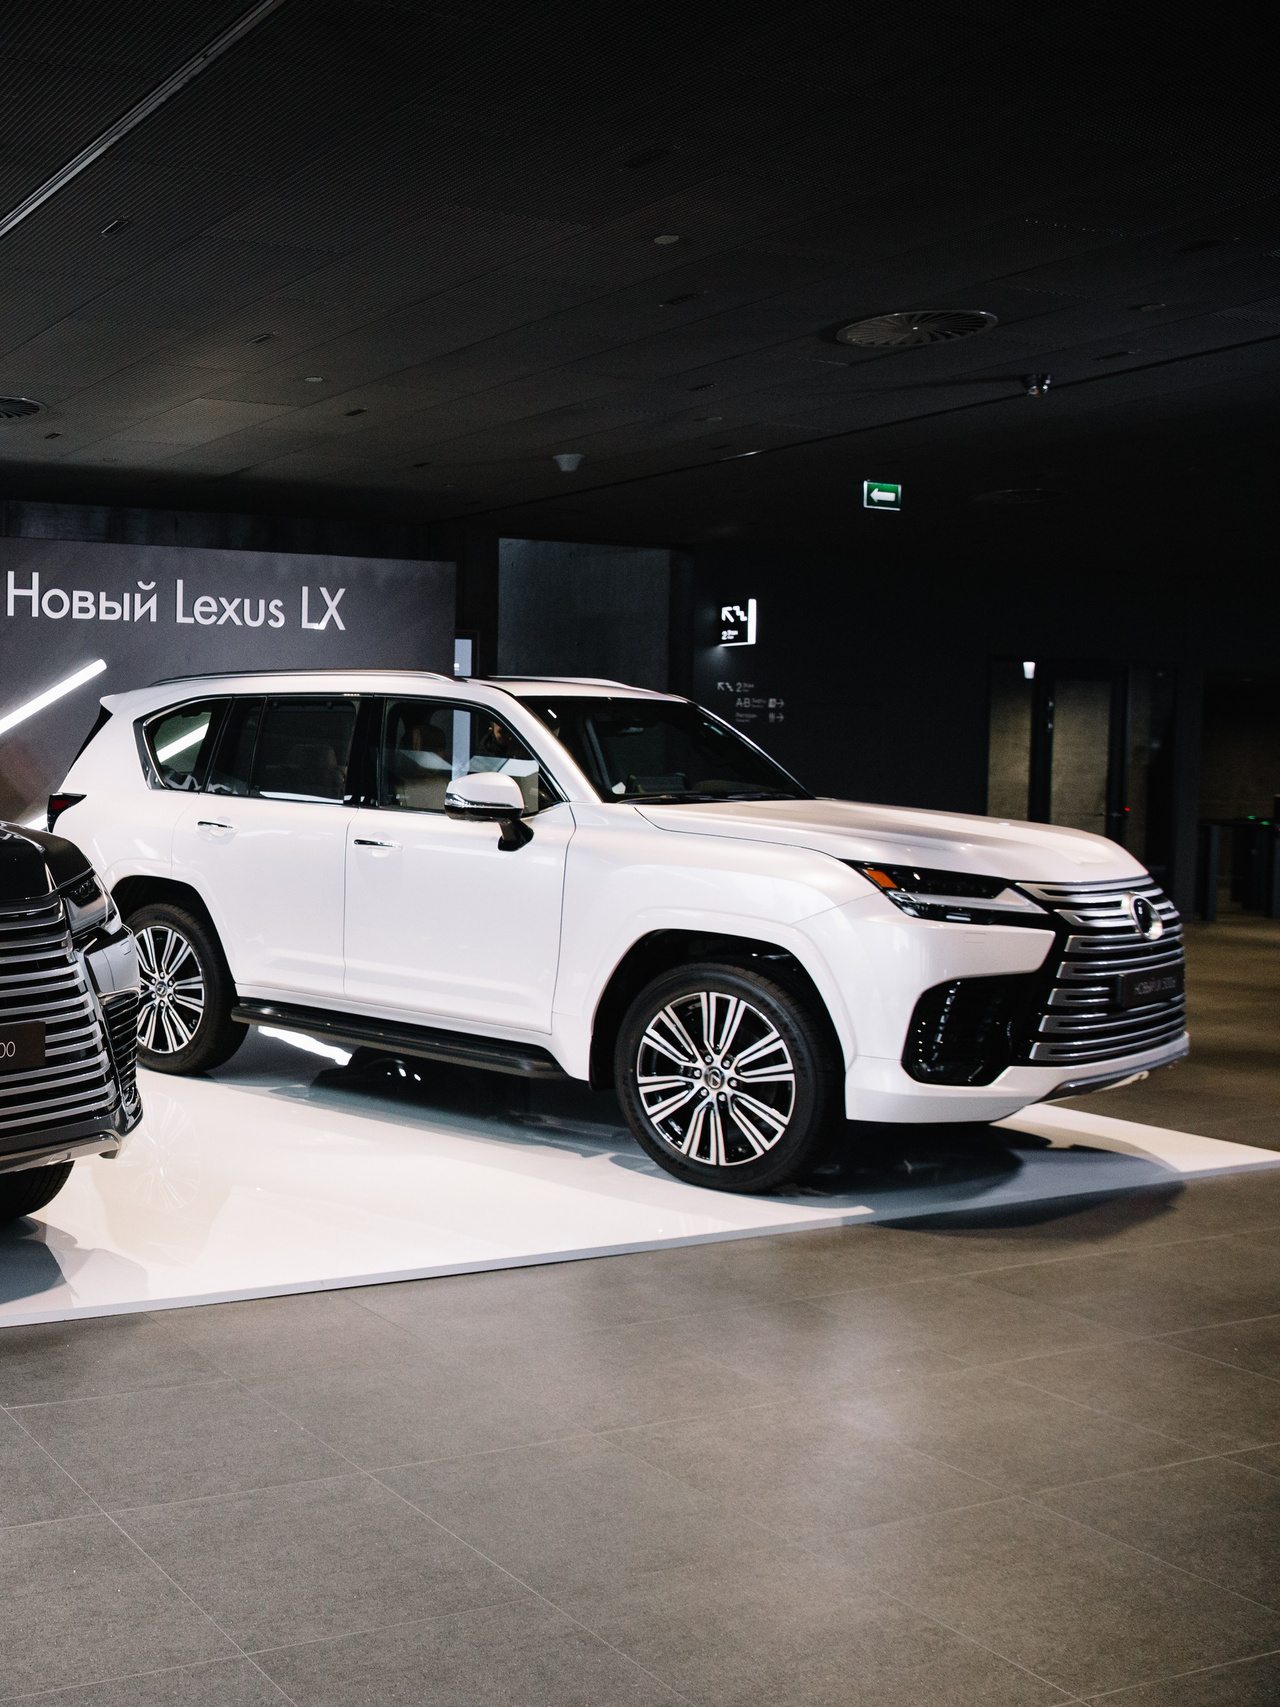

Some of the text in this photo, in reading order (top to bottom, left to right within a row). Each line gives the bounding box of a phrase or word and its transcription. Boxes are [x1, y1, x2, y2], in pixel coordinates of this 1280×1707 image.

[6, 570, 347, 631] Новый Lexus LX
